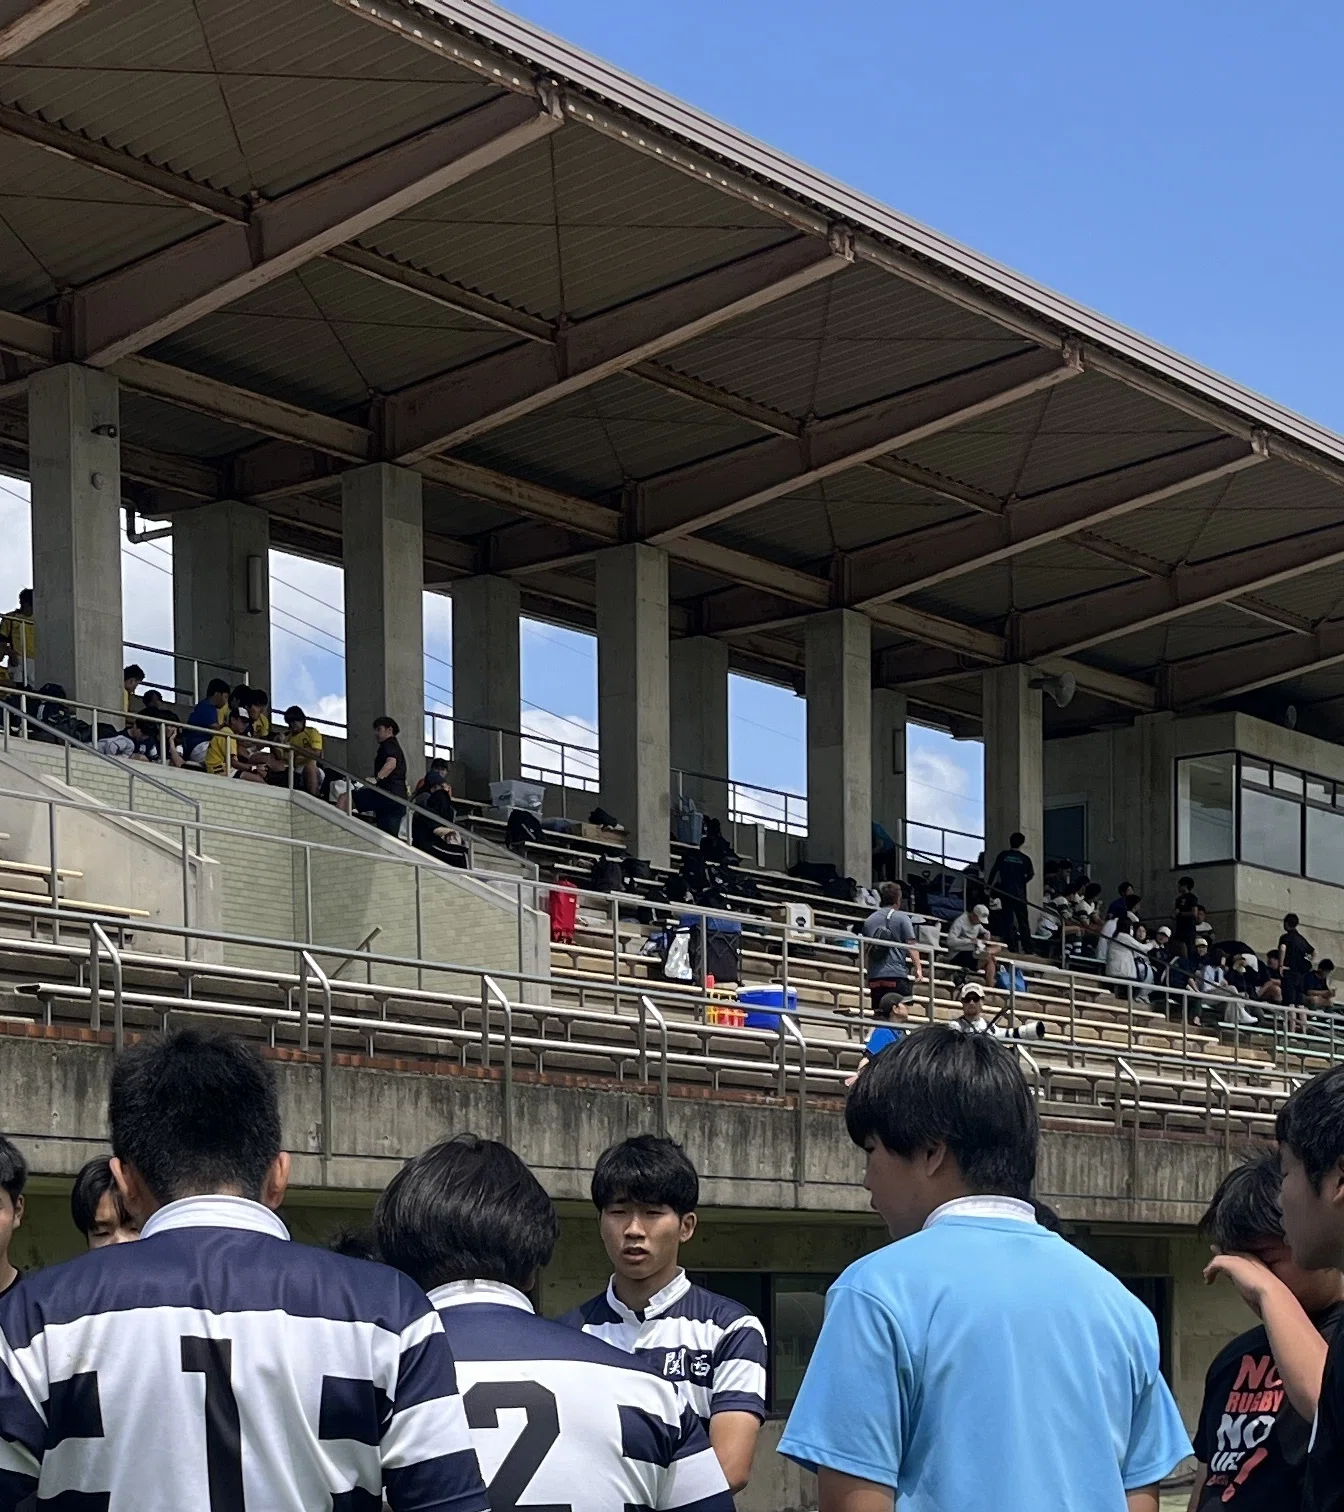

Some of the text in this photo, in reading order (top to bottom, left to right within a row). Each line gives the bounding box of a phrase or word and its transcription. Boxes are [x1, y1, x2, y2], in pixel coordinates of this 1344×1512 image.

[662, 1348, 712, 1377] 関西
[1225, 1390, 1284, 1413] RUGBY
[1217, 1413, 1276, 1450] NO
